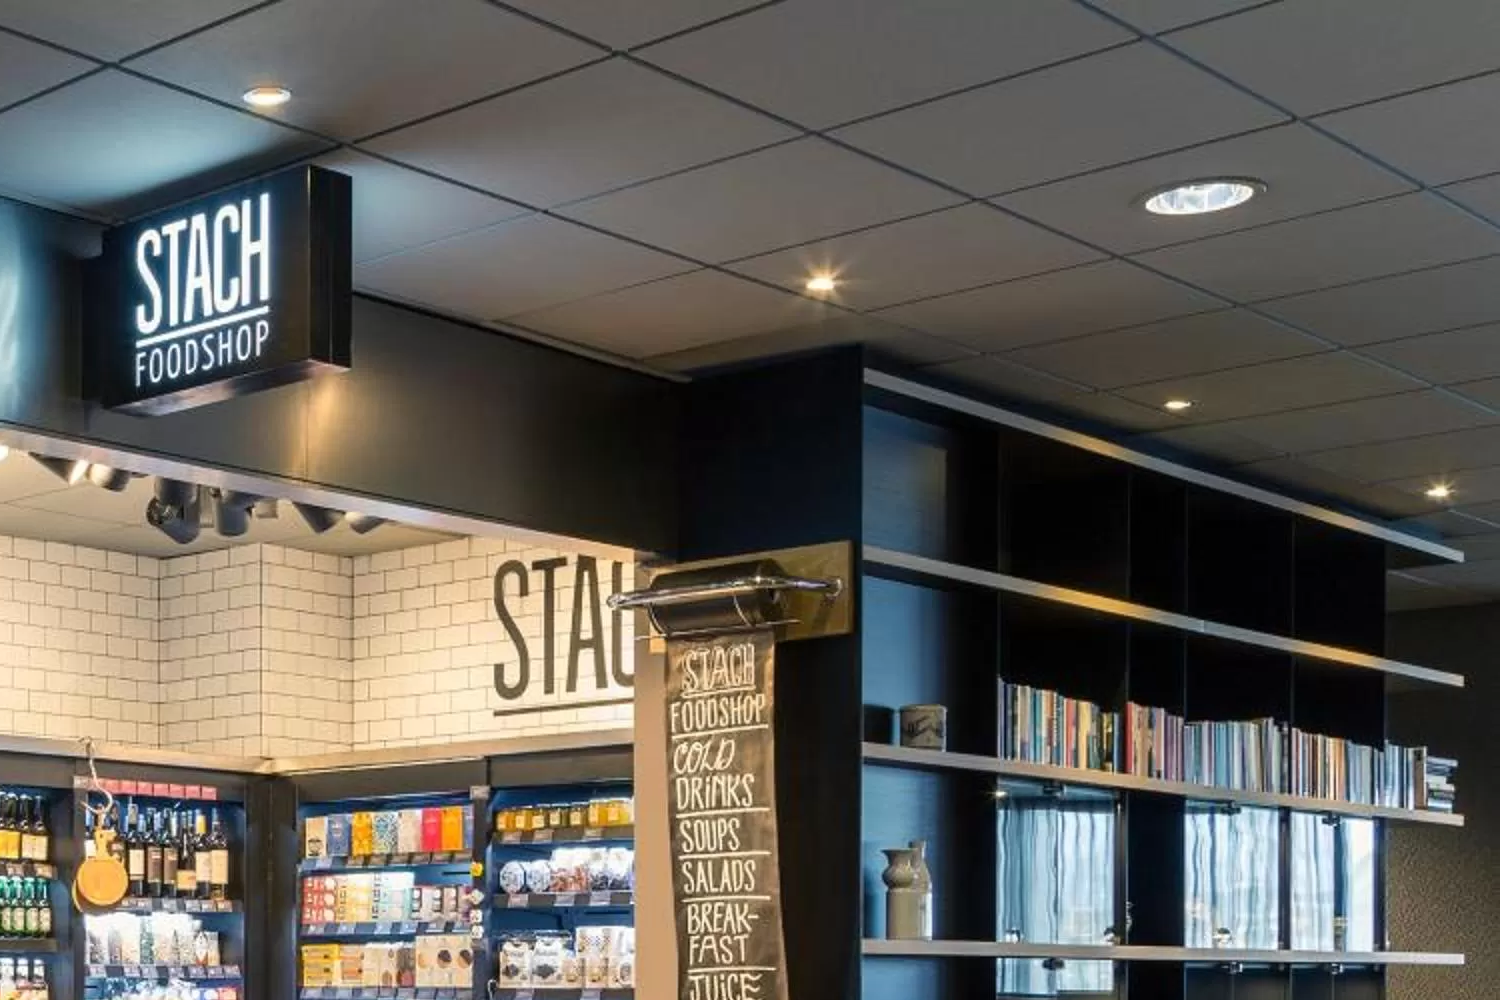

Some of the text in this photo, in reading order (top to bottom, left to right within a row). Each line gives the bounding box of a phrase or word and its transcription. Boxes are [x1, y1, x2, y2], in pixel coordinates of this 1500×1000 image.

[135, 193, 270, 335] STACH
[135, 319, 270, 387] FOODSHOP
[681, 643, 756, 690] STACH
[671, 693, 766, 732] FOODSHOP
[673, 738, 735, 773] COLD
[679, 817, 741, 853] SOUPS
[681, 860, 757, 894] SALADS
[687, 902, 760, 934] BREAK-
[689, 934, 750, 965] FAST
